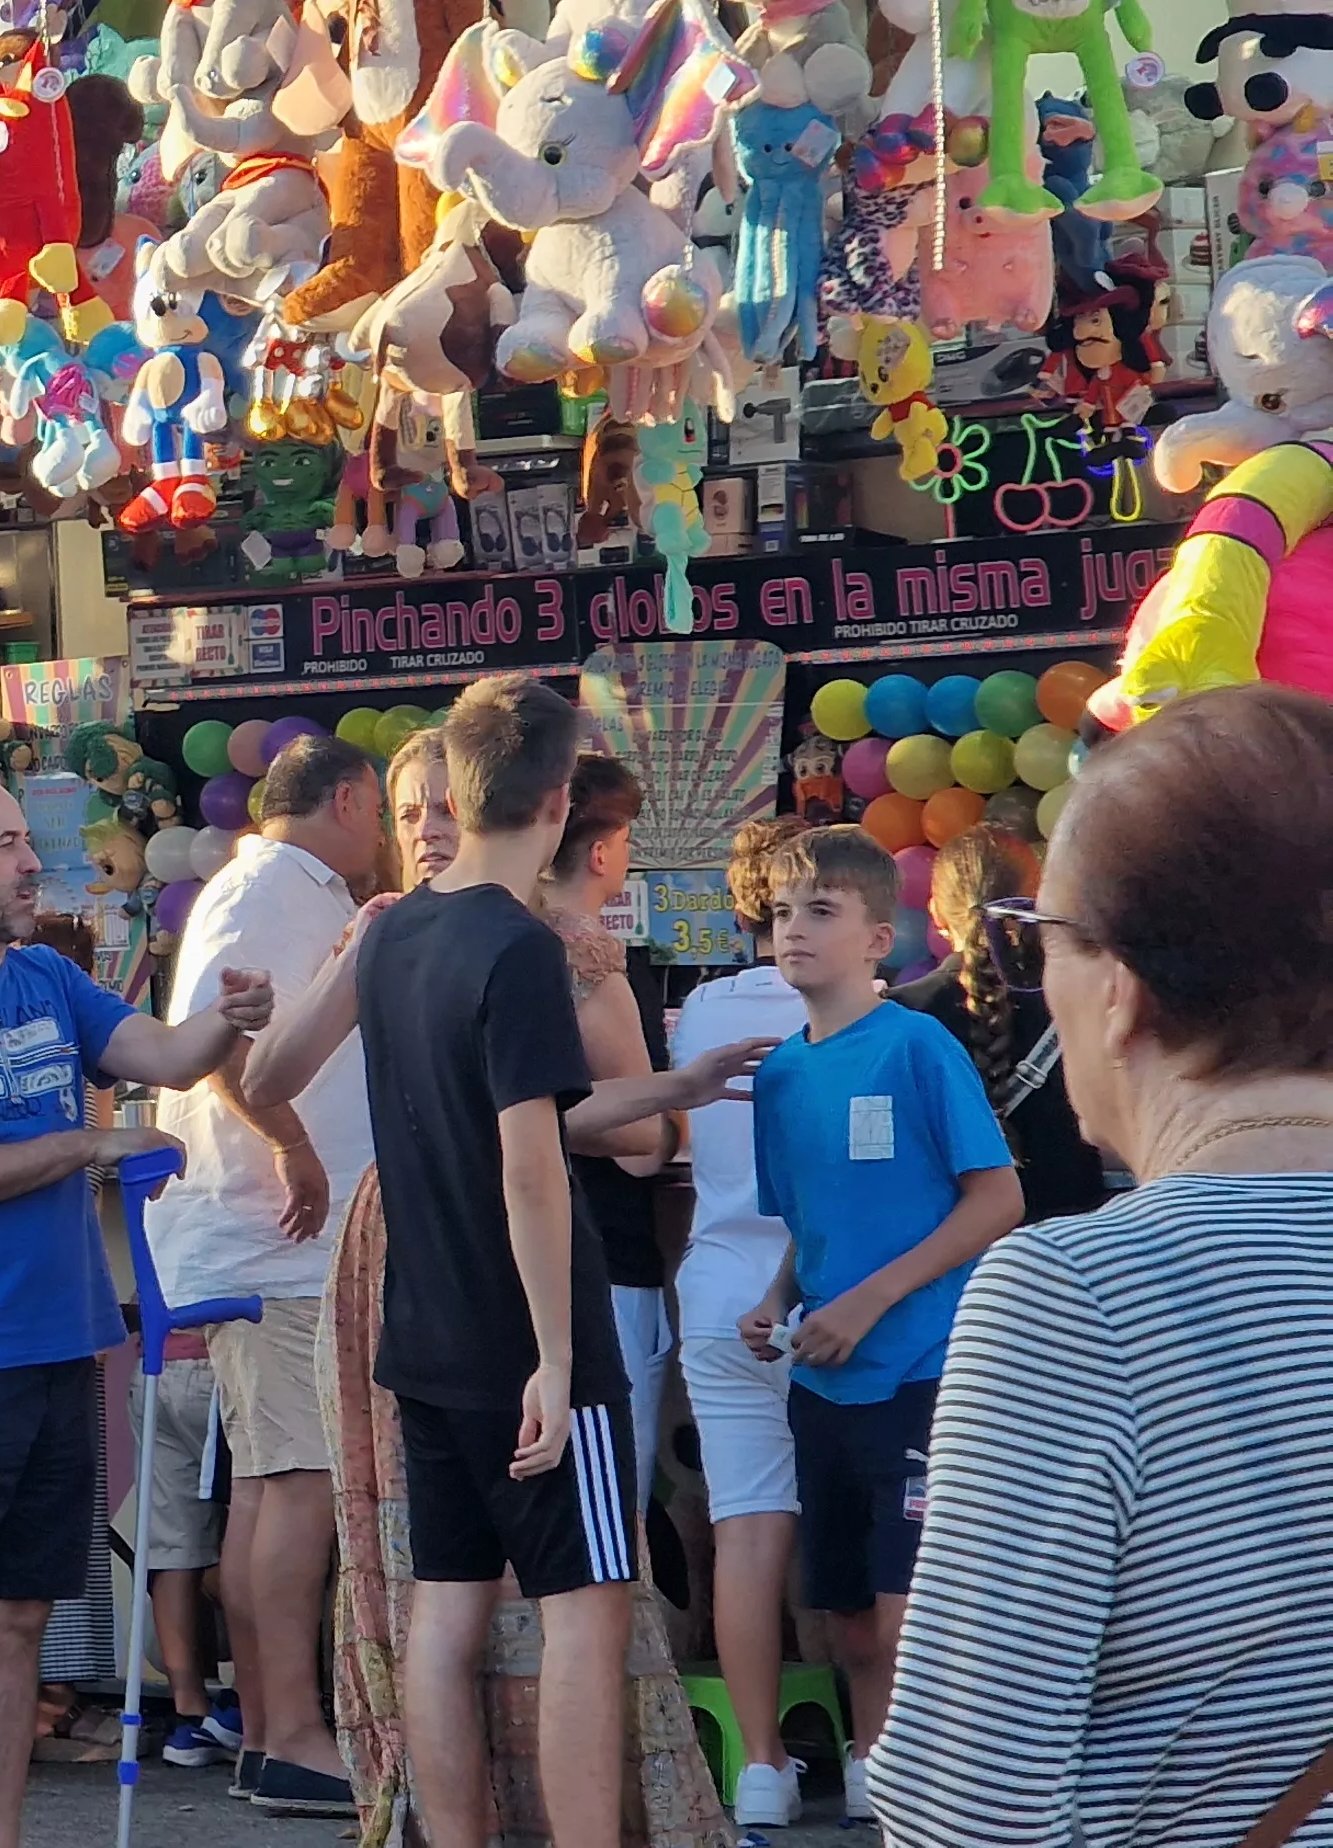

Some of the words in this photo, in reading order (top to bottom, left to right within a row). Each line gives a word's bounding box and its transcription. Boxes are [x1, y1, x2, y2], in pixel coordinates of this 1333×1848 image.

[312, 584, 522, 656] Pinchando
[535, 577, 565, 642] 3
[760, 577, 812, 625] en
[833, 558, 875, 621] la
[897, 550, 1051, 617] misma
[195, 624, 225, 641] TIRAR
[834, 621, 906, 638] PROHIBIDO
[909, 618, 948, 636] TIRAR
[950, 613, 1019, 632] CRUZADO
[195, 645, 226, 662] RECTO
[306, 658, 368, 675] PROHIBIDO
[390, 655, 424, 669] TIRAR
[426, 650, 485, 668] CRUZADO
[24, 673, 114, 704] REGLAS
[653, 883, 669, 912] 3
